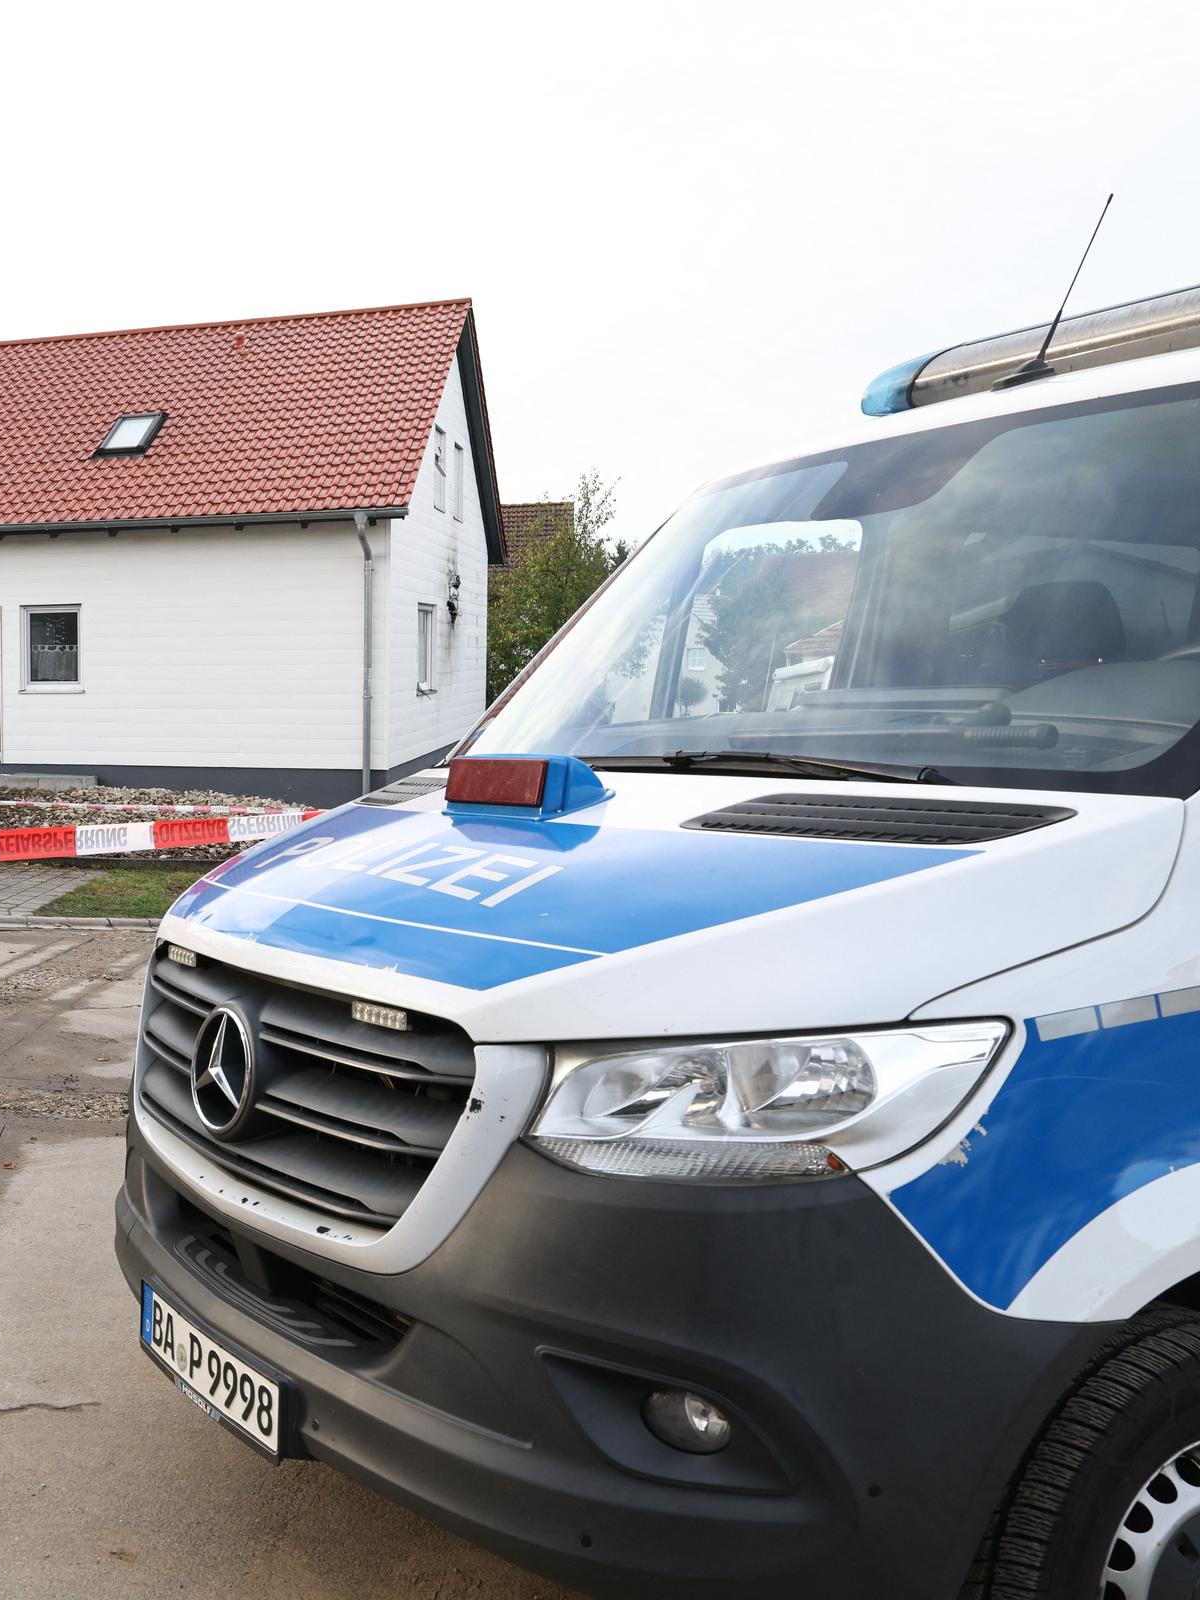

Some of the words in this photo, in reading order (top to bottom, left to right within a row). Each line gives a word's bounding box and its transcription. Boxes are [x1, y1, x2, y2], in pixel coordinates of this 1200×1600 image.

[255, 836, 564, 908] POLIZEI
[152, 1299, 175, 1362] BA
[189, 1332, 203, 1379] P
[207, 1349, 273, 1437] 9998
[181, 1385, 212, 1414] MOSOLF
